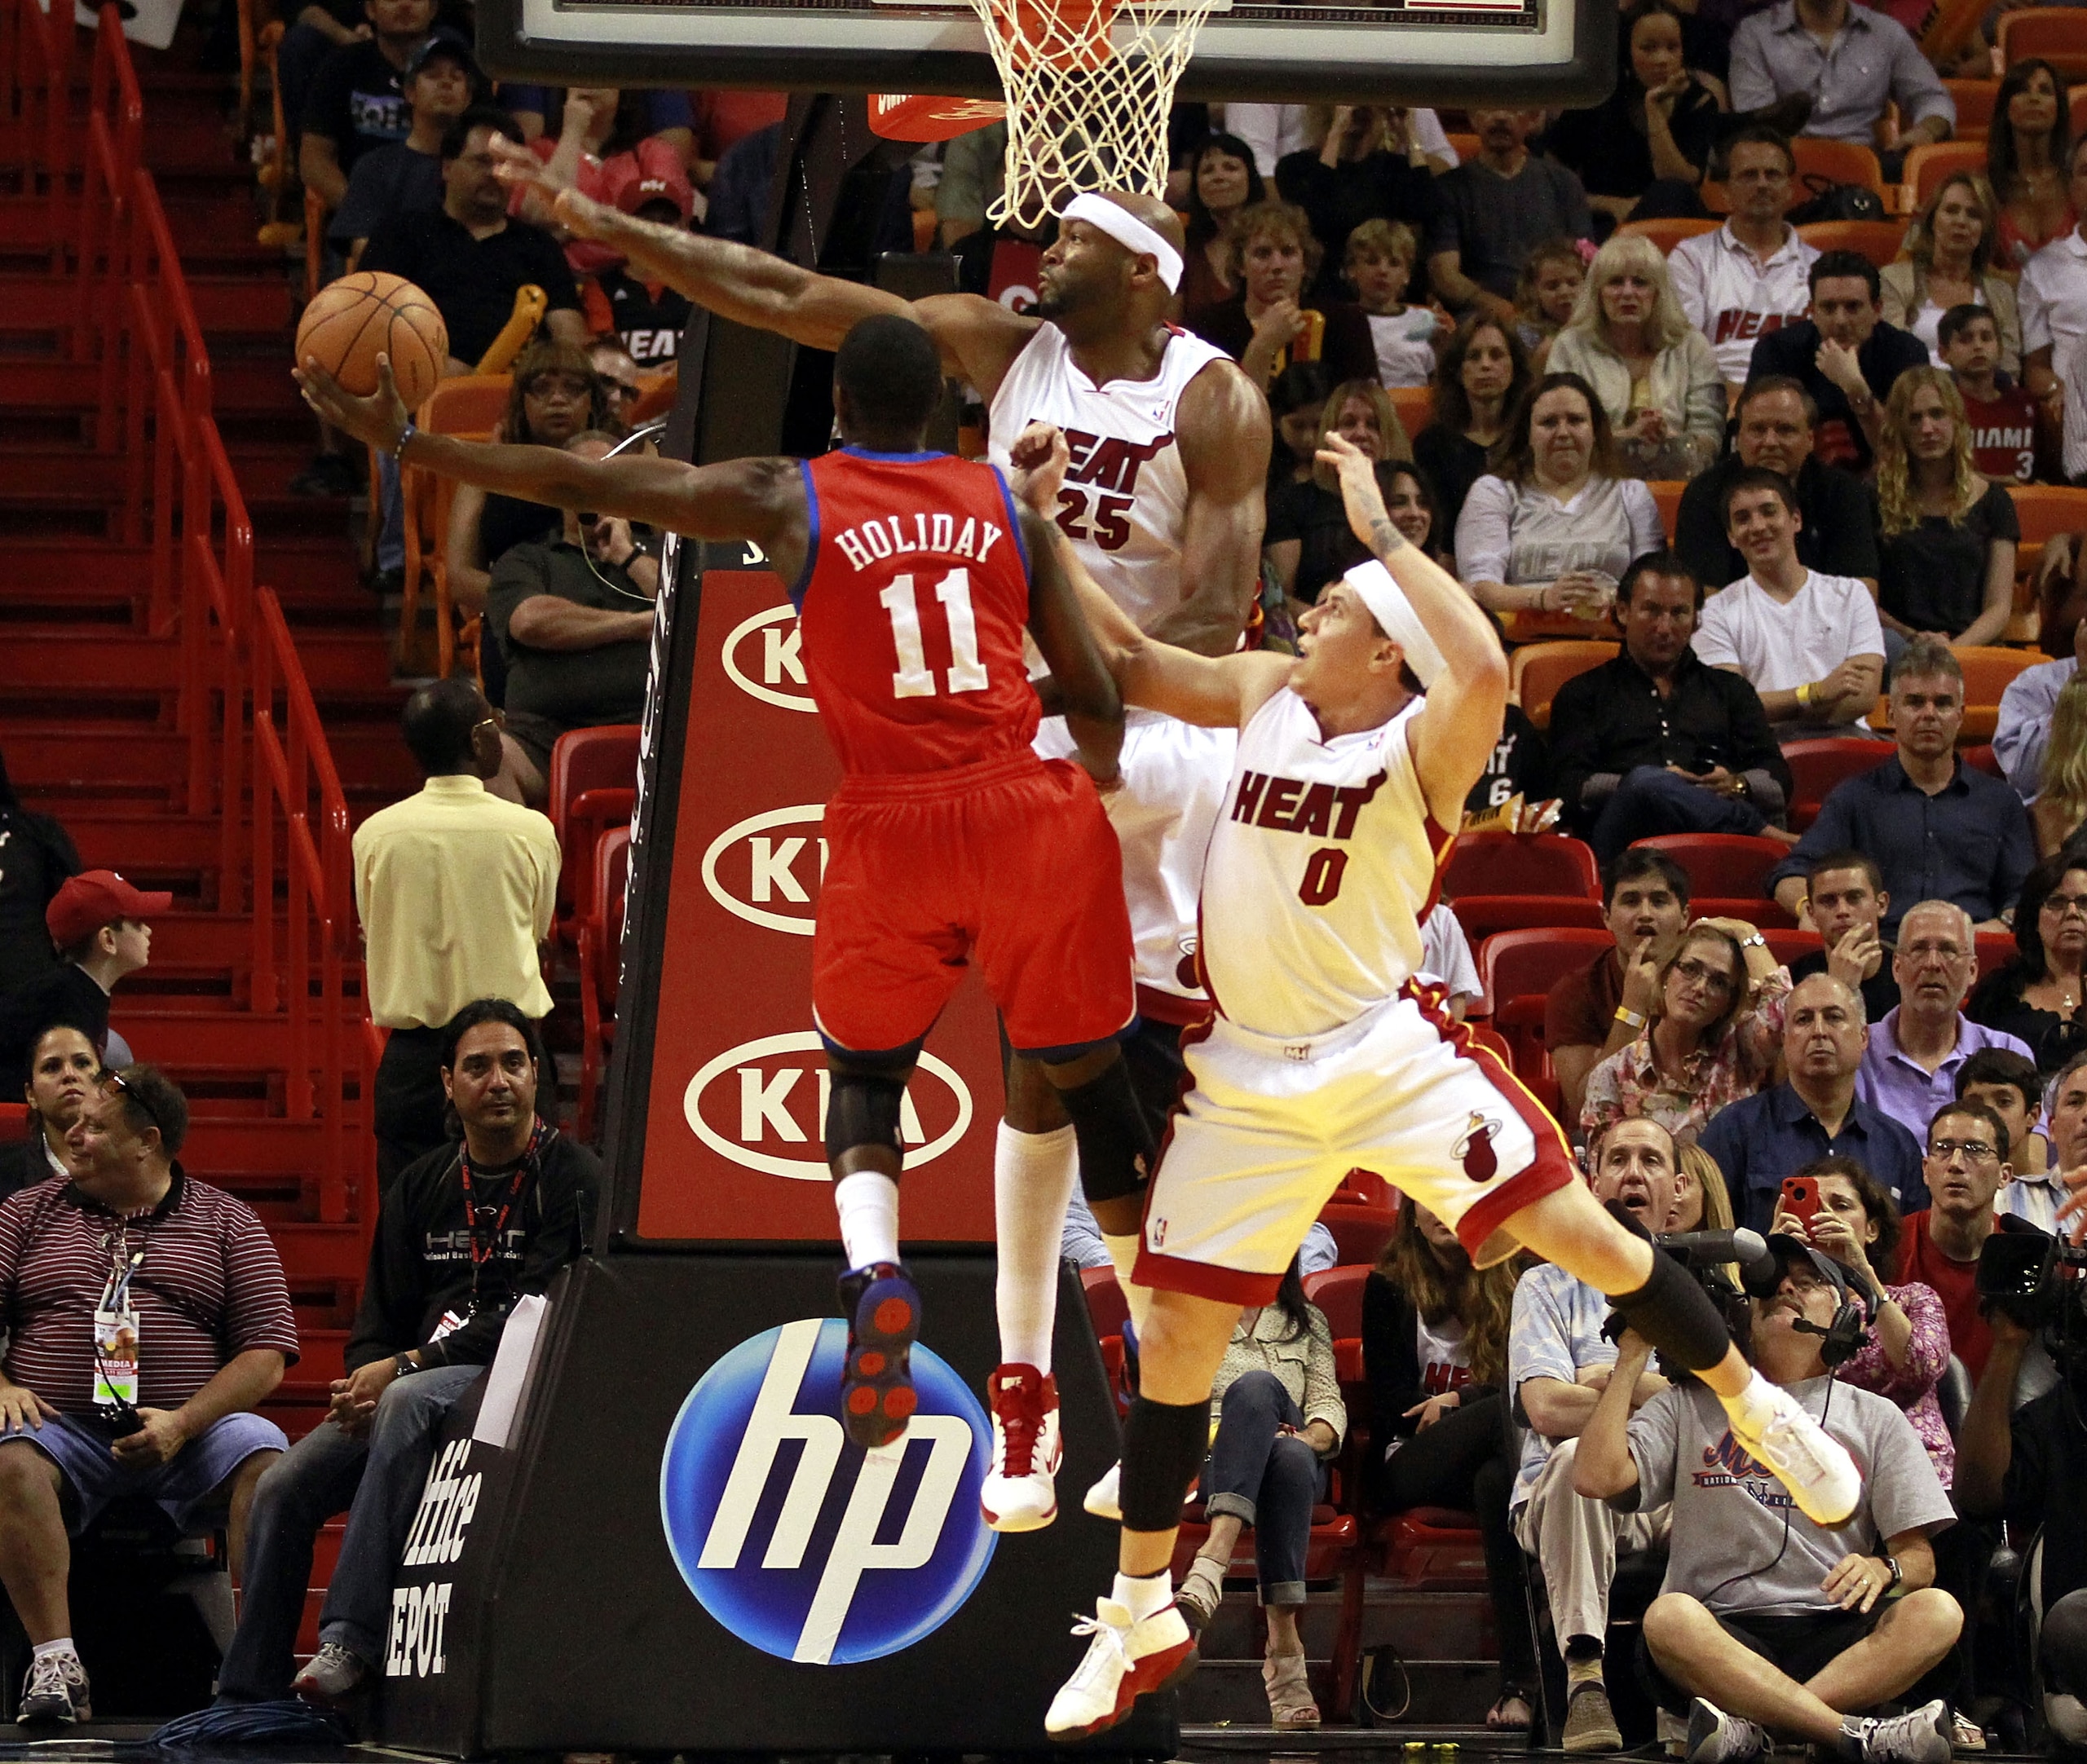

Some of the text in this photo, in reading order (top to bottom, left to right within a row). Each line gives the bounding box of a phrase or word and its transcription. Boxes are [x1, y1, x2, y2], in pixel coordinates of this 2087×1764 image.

[620, 330, 684, 359] EA
[1025, 418, 1174, 494] EAT
[2015, 451, 2034, 479] 3
[835, 513, 1002, 571] HOLIDAY
[1057, 487, 1134, 551] 25
[879, 567, 989, 699] 11
[1232, 767, 1388, 840] HEAT
[1489, 777, 1512, 807] 6
[1299, 848, 1349, 906] 0
[426, 1229, 526, 1250] HET
[402, 1438, 483, 1567] ffice
[697, 1318, 973, 1665] hp
[1704, 1476, 1738, 1484] NATION
[385, 1582, 453, 1678] EPOT
